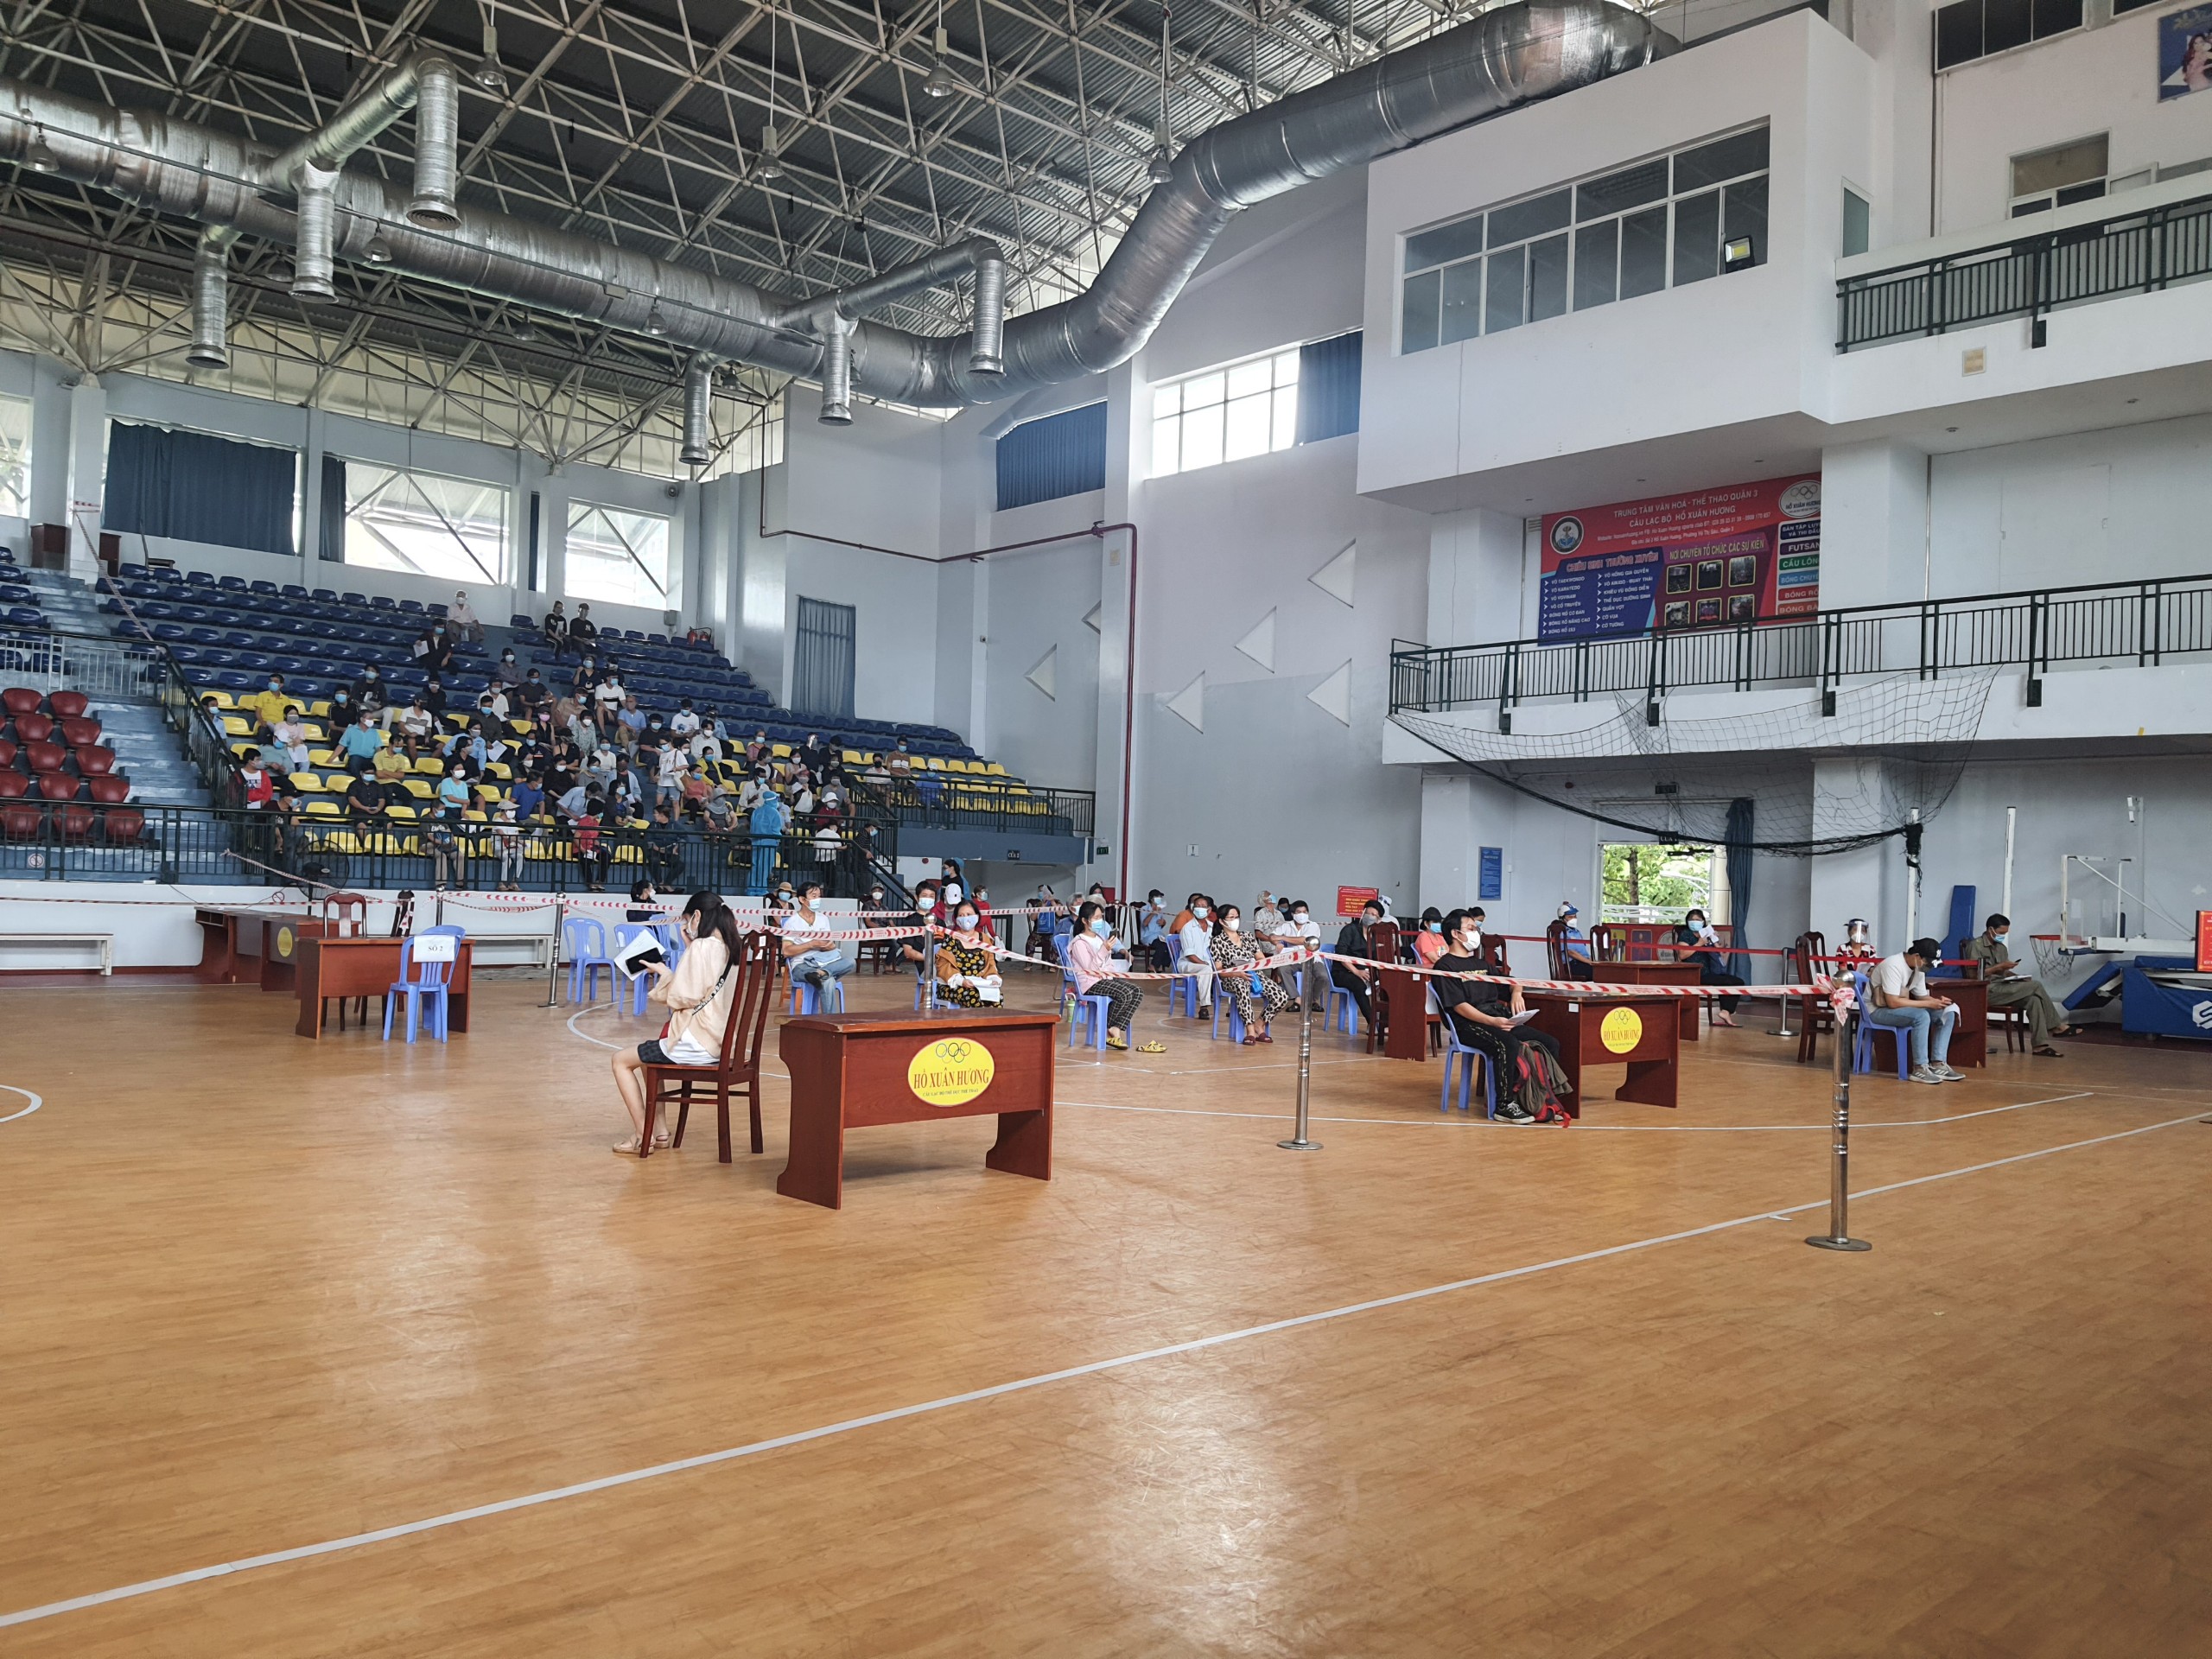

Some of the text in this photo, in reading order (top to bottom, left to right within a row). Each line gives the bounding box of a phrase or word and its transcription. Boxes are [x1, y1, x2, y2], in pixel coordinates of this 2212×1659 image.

[1614, 508, 1637, 518] TRUNG
[1708, 493, 1728, 504] THAO
[1688, 507, 1707, 518] XUÂN
[1802, 556, 1818, 566] LÔN
[914, 1067, 989, 1089] HỒ XUÂN HƯƠNG
